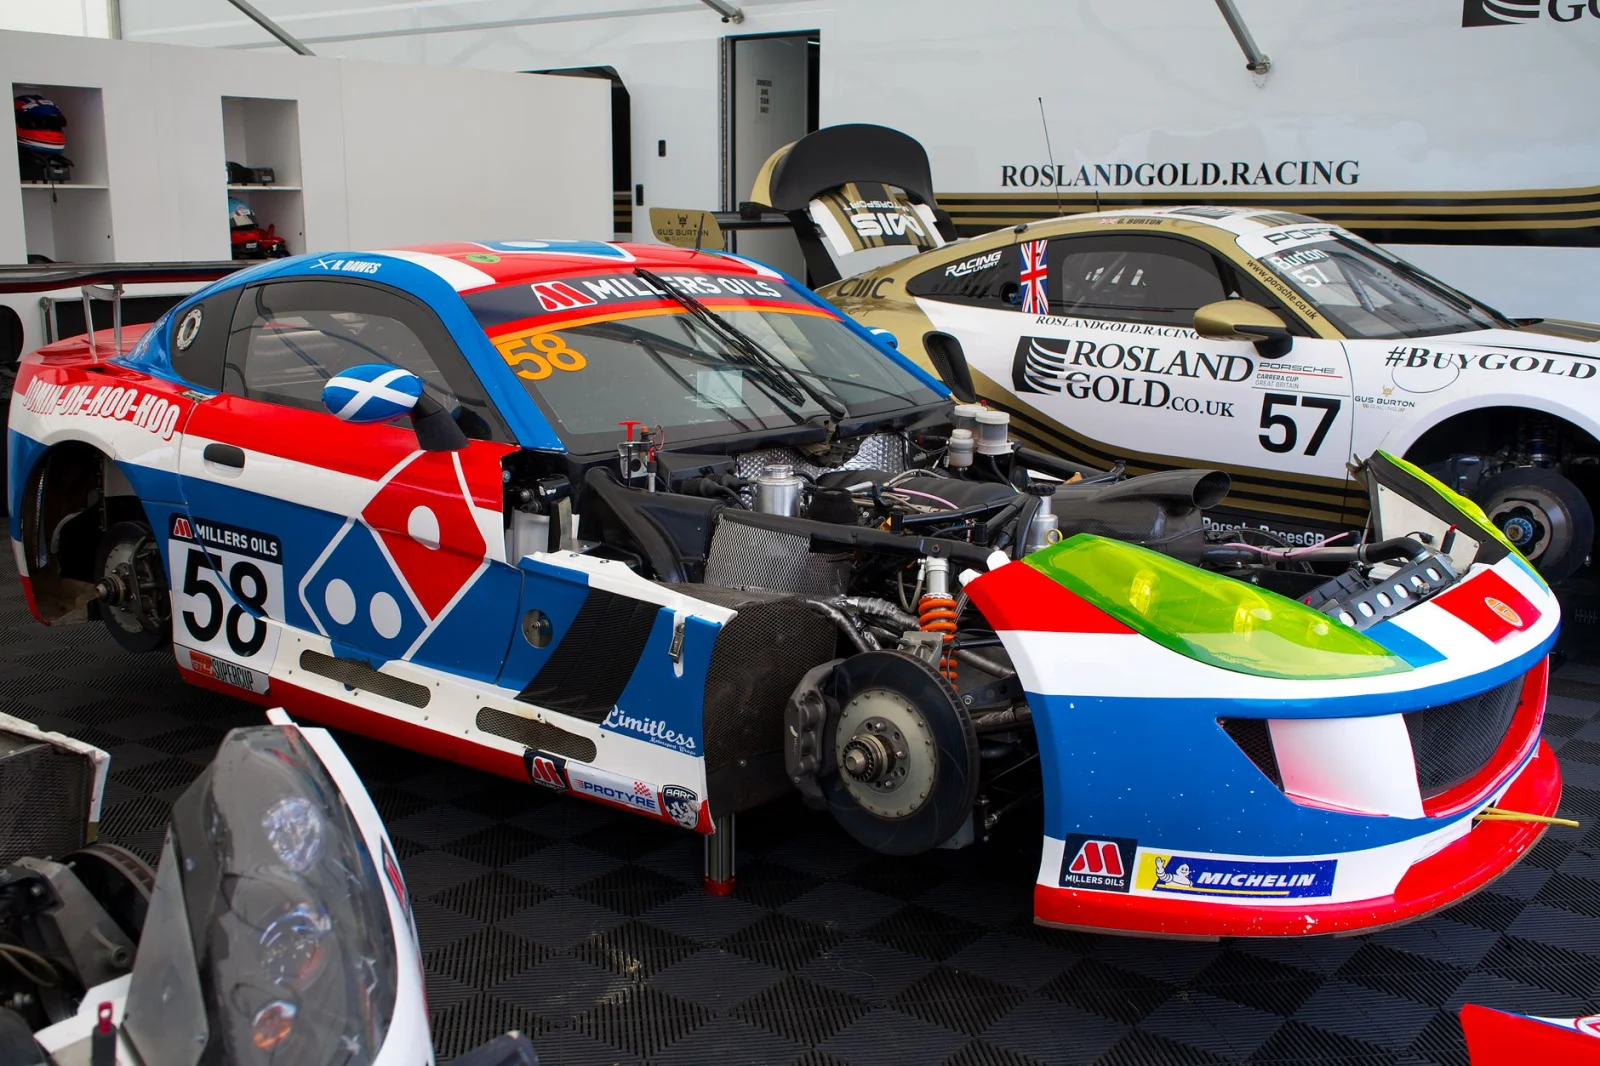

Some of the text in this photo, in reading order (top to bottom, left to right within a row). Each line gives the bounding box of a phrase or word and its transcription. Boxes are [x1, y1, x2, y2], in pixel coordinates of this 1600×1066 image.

[1548, 0, 1600, 22] G
[1000, 160, 1360, 188] ROSLANDGOLD.RACING
[657, 228, 709, 237] GUS BURTN
[1126, 218, 1164, 226] BURTON
[342, 260, 382, 274] DAWES
[945, 250, 1003, 277] RACING
[1268, 247, 1330, 272] Burton
[717, 277, 782, 298] OILS
[1290, 264, 1331, 288] 57
[1246, 259, 1318, 320] www.porsche.co.uk
[1036, 315, 1200, 340] ROSLANDGOLD.RACING
[495, 333, 587, 380] 58
[1070, 340, 1254, 383] ROSLAND
[1259, 362, 1336, 374] PORSCHE
[1384, 346, 1598, 379] #BUYGOLD
[1256, 373, 1285, 381] CARRERA
[1275, 381, 1300, 389] BRITAIN
[1355, 395, 1416, 407] GUS BURTON
[1258, 392, 1342, 457] 57
[194, 524, 278, 556] MILLERS OILS
[182, 548, 269, 657] 58
[211, 659, 254, 691] SUPERCUP
[603, 704, 696, 749] Limitless
[583, 781, 656, 809] PROTYRE
[1064, 874, 1125, 887] MILLERS OILS
[1197, 871, 1317, 887] MICHELIN
